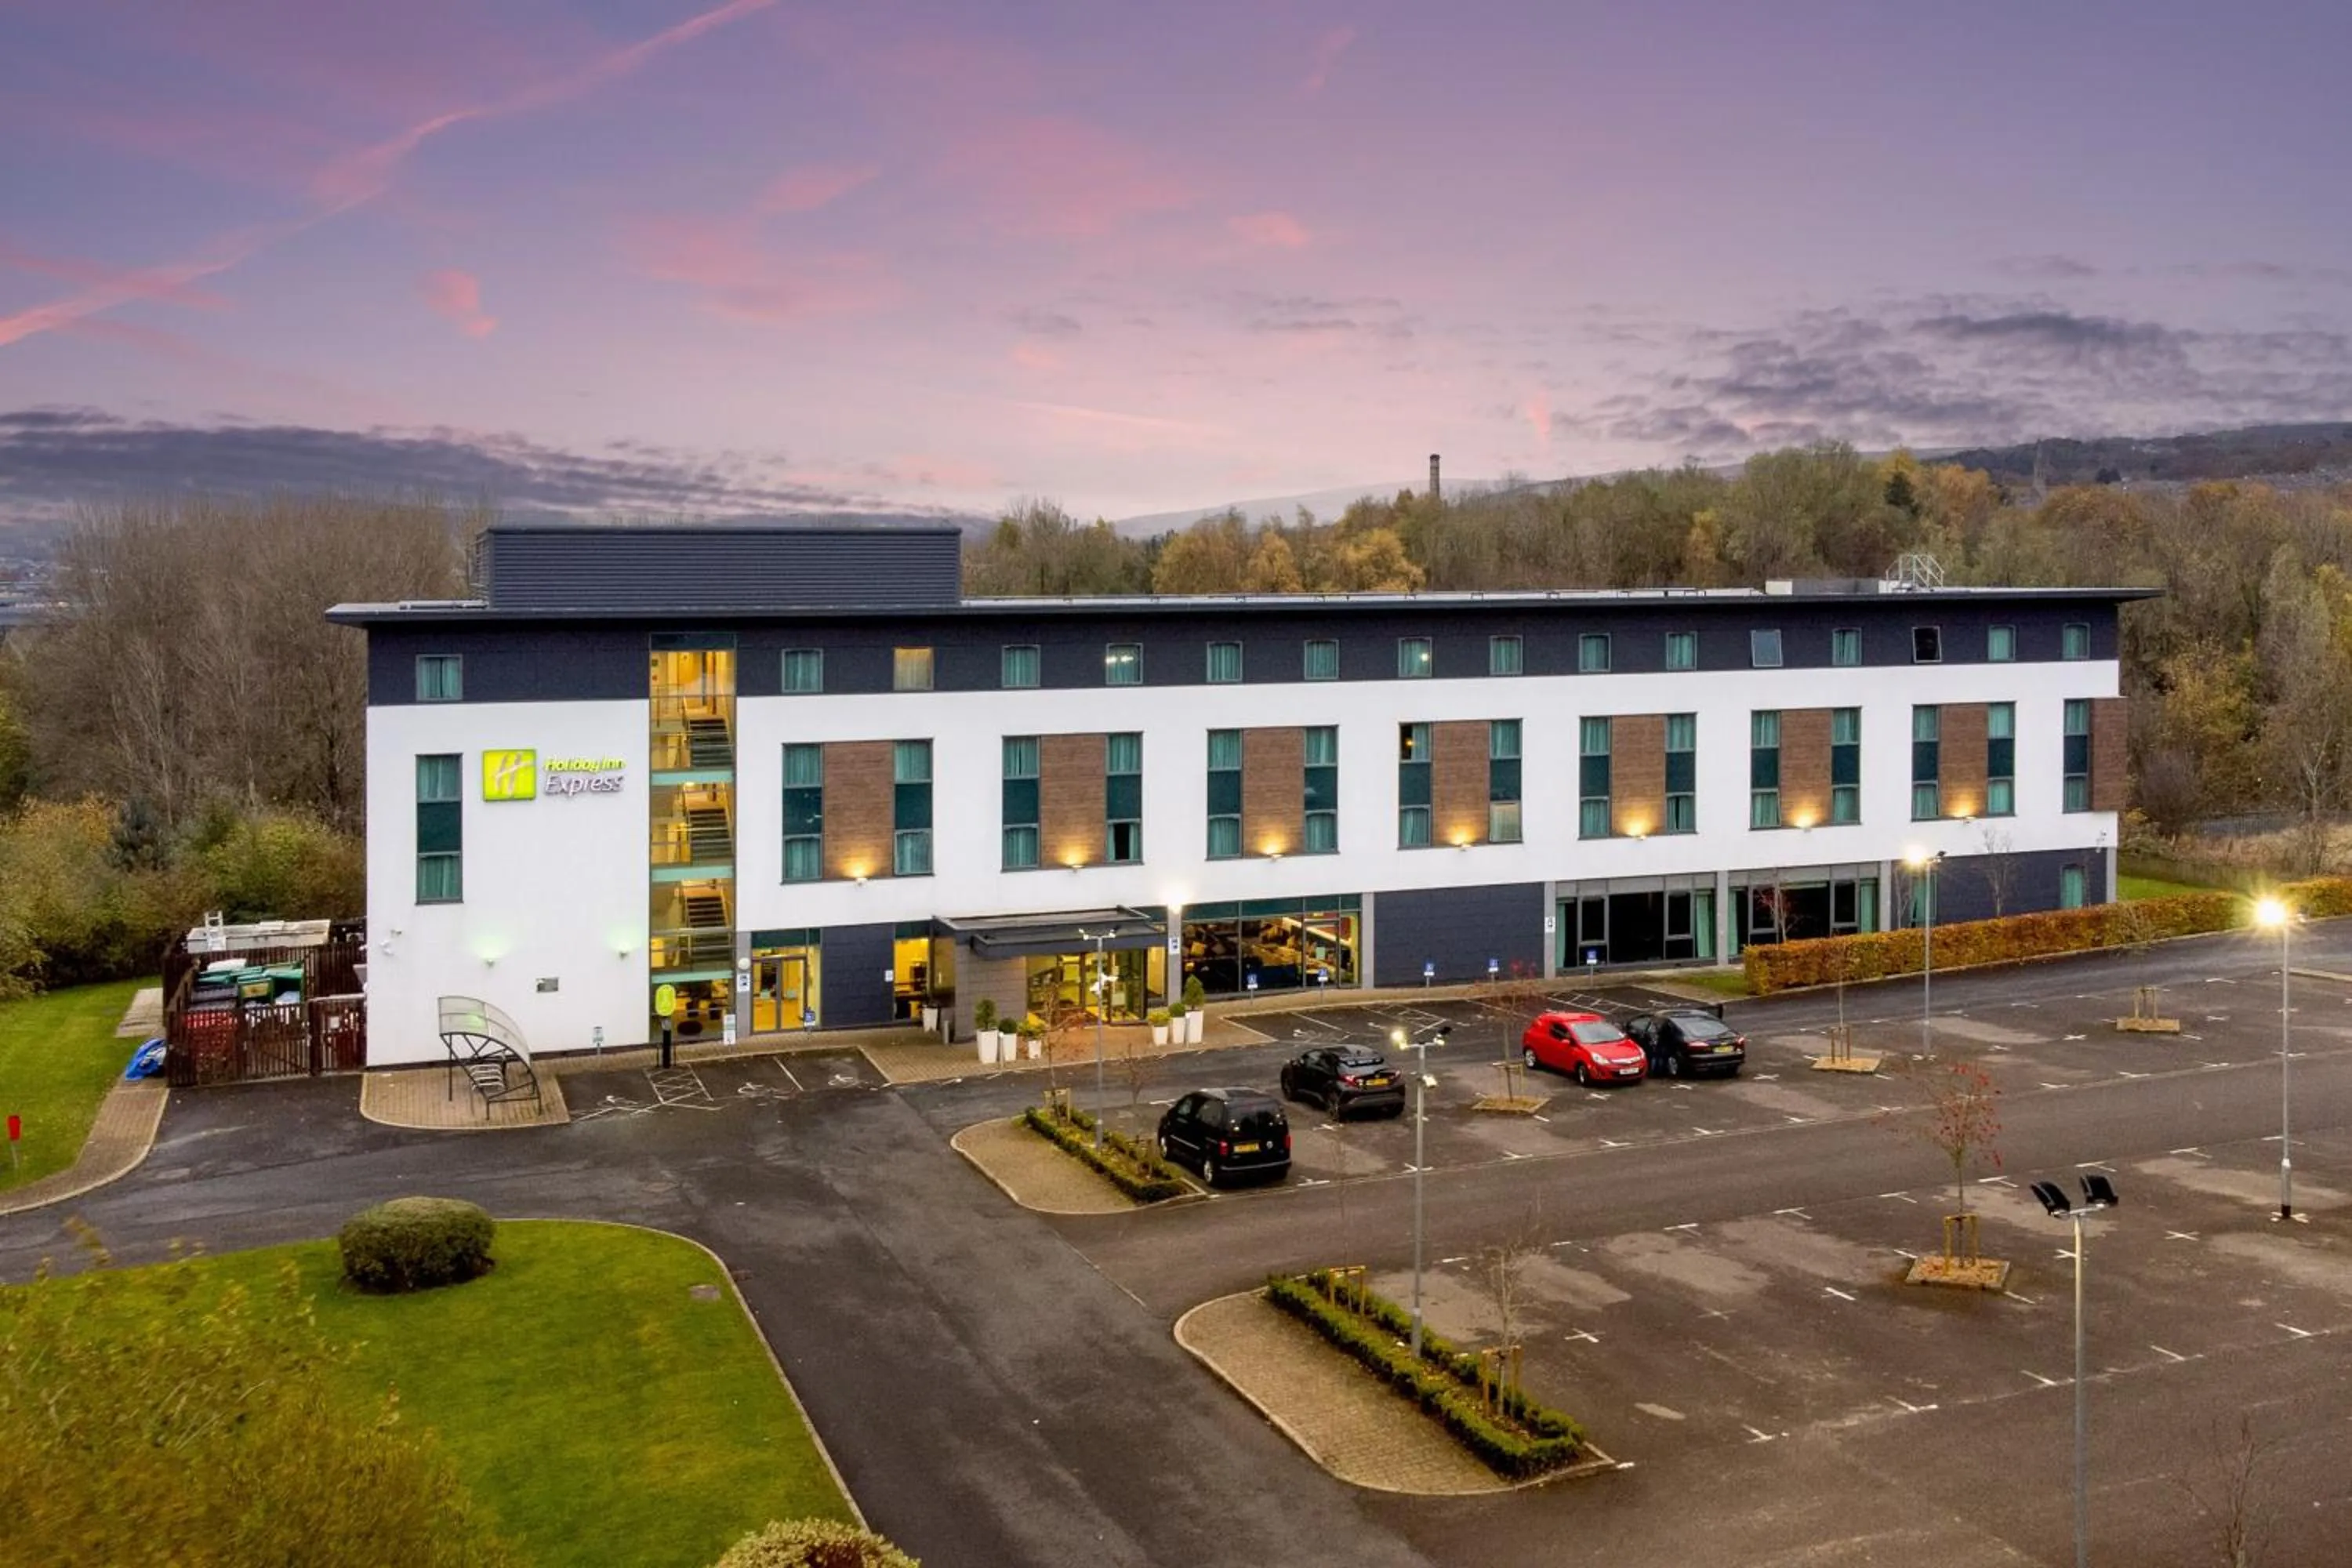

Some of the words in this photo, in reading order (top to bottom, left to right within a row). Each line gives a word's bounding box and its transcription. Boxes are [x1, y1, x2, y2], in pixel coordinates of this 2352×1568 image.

[544, 757, 600, 773] Holiday
[601, 757, 626, 770] Inn
[544, 774, 625, 797] Express
